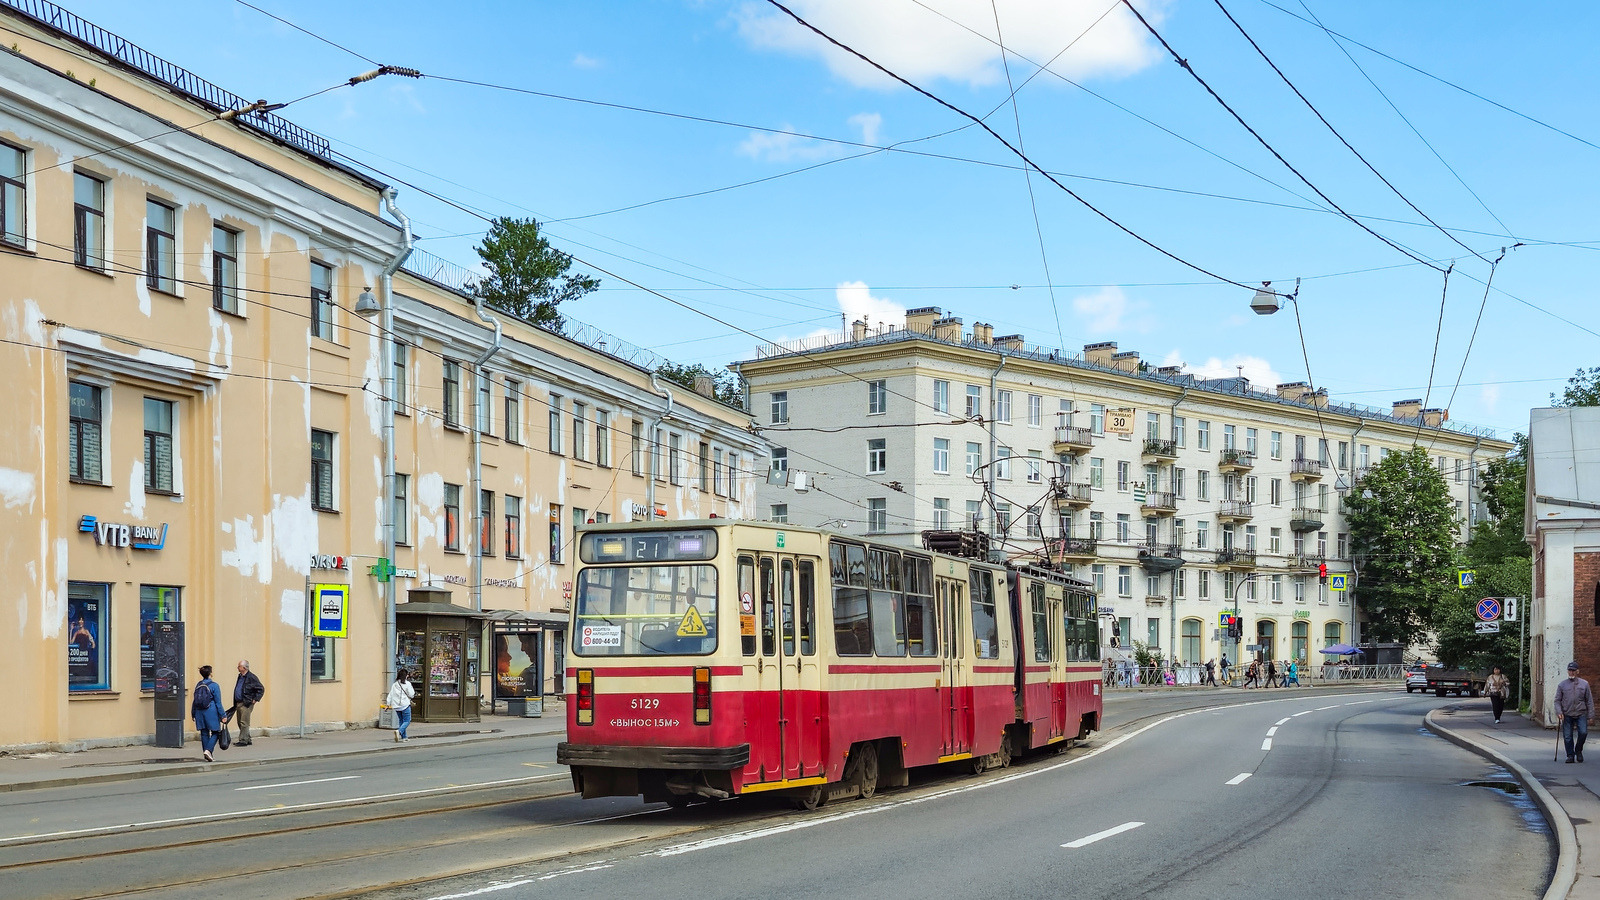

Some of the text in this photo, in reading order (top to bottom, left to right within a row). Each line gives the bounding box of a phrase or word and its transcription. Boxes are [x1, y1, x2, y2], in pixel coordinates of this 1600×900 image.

[1113, 417, 1125, 427] 30
[97, 522, 159, 548] VTB BANK
[636, 541, 659, 559] 21
[70, 648, 79, 656] 200
[631, 698, 660, 709] 5129
[616, 718, 652, 727] ВЫНОС
